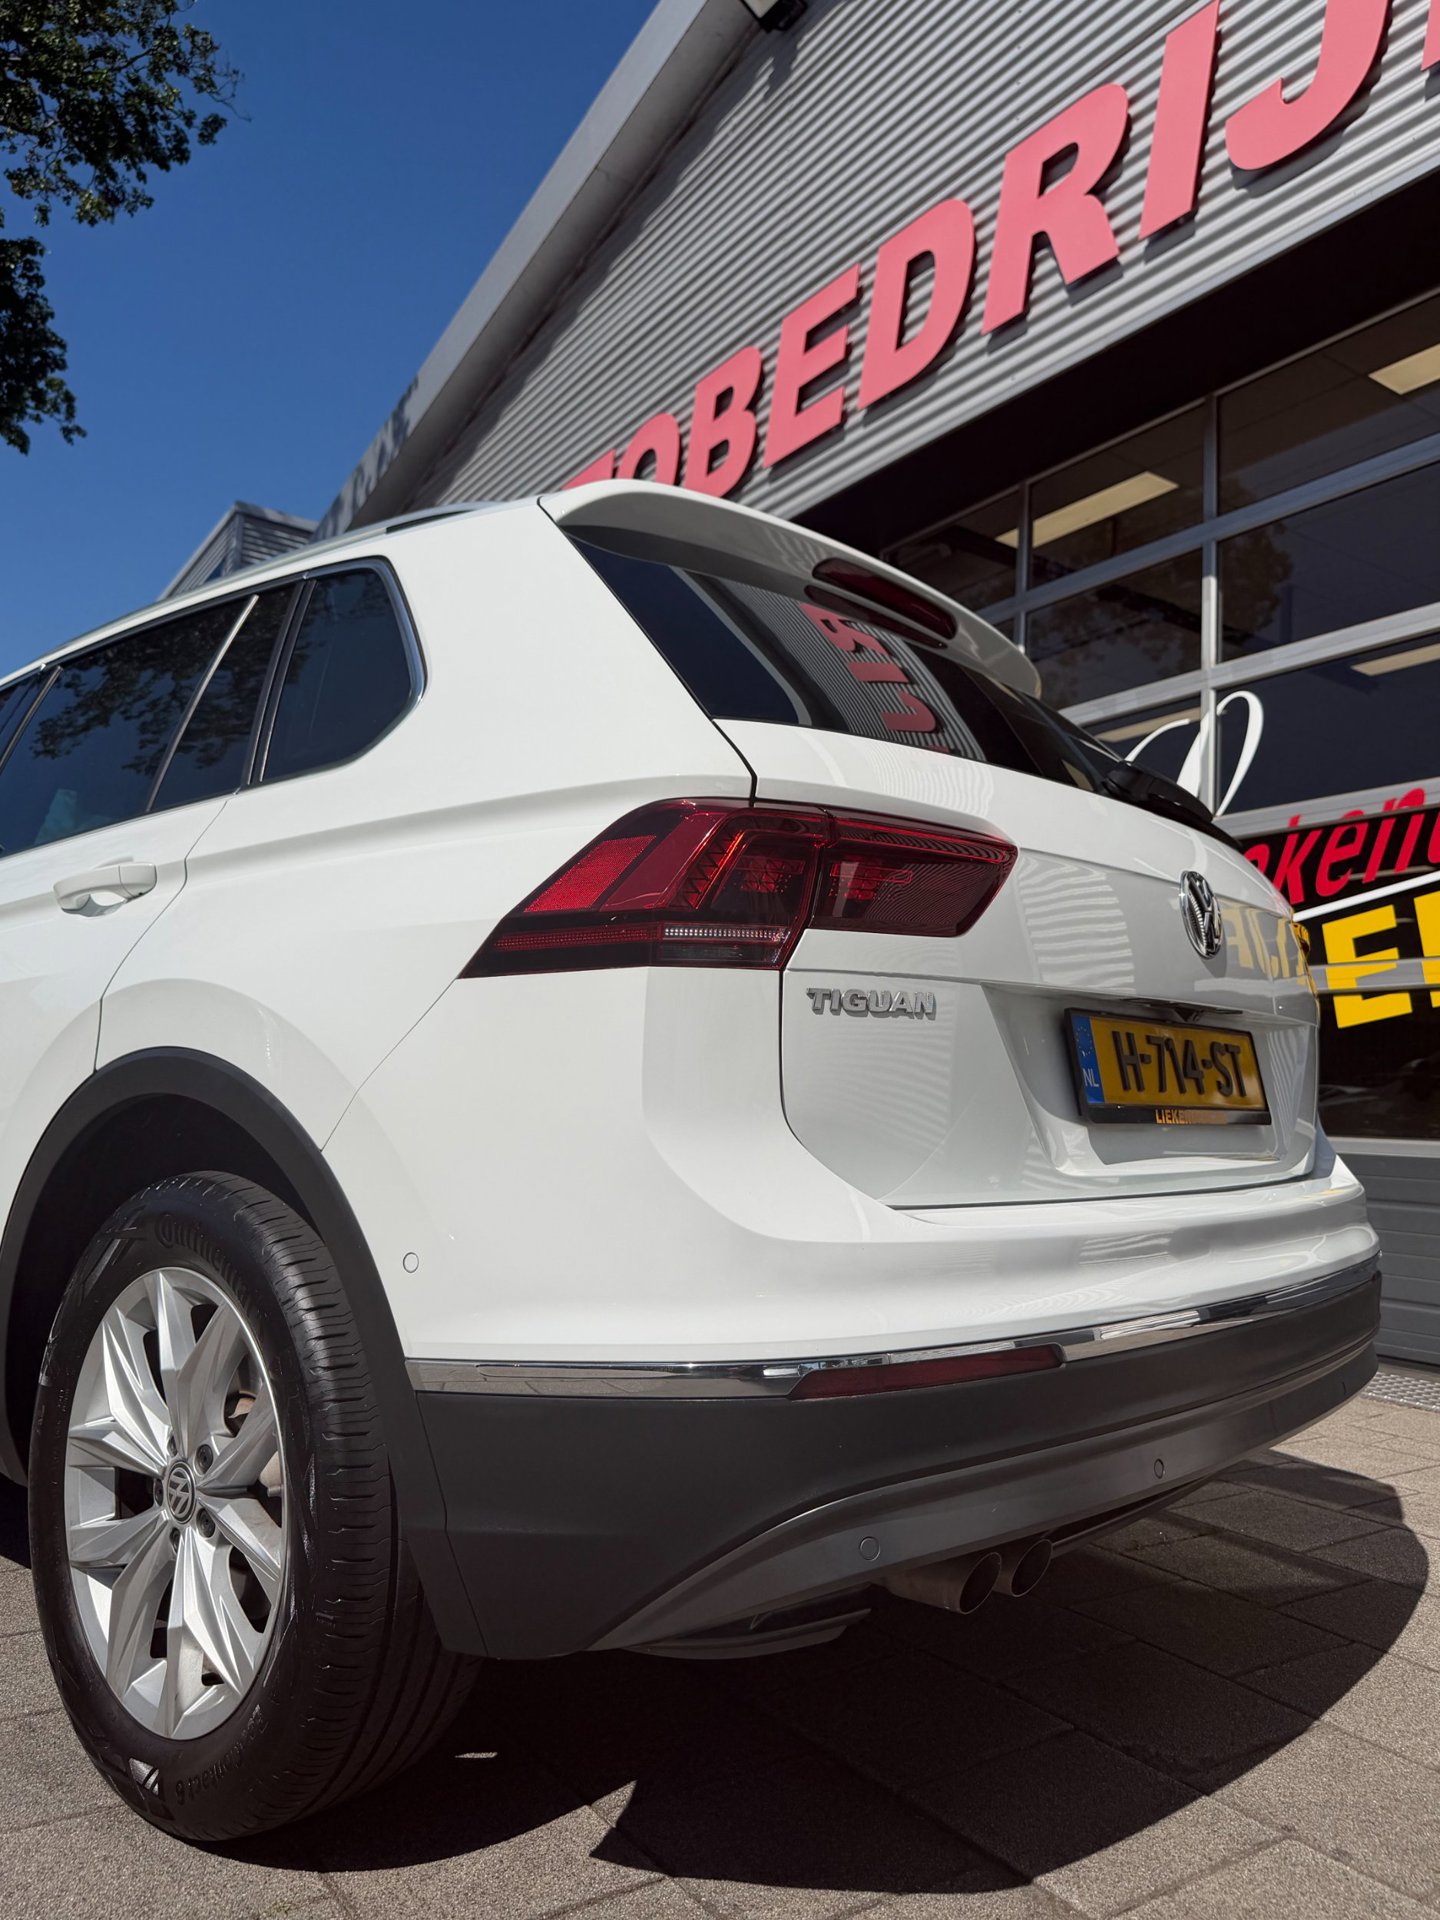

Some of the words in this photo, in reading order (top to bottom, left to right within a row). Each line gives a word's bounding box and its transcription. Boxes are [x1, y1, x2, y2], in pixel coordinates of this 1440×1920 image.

[806, 987, 937, 1018] TIGUAN
[1082, 1068, 1099, 1088] NL
[1111, 1030, 1247, 1098] H-714-ST
